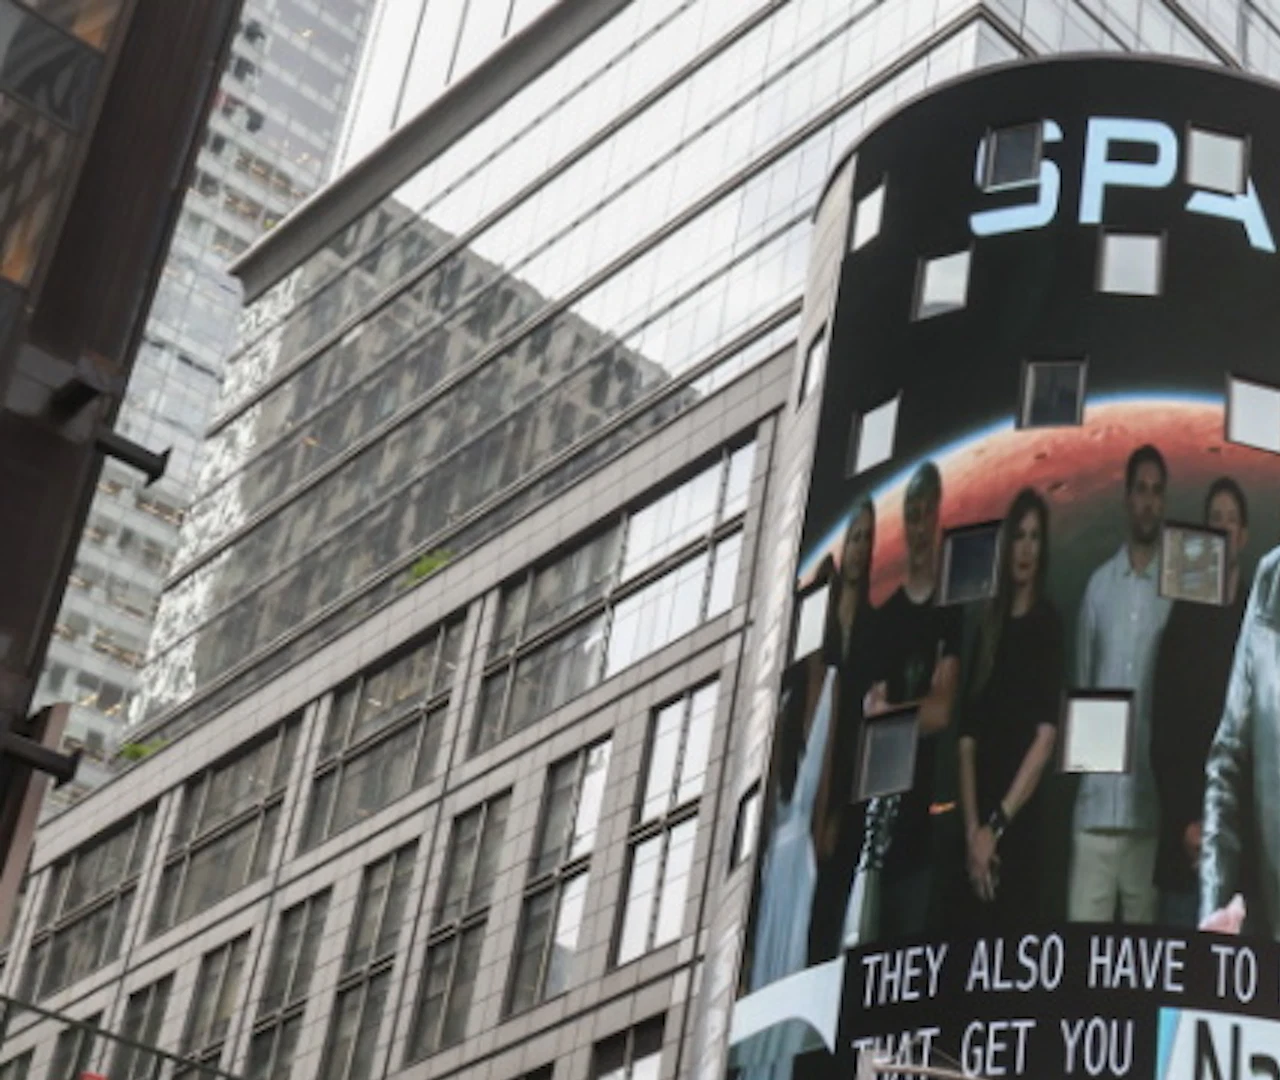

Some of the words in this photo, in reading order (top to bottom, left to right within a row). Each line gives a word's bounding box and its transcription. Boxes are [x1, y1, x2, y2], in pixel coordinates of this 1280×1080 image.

[862, 943, 948, 1009] THEY
[965, 933, 1065, 992] ALSO
[1088, 935, 1186, 992] HAVE
[1211, 944, 1257, 1003] TO
[961, 1020, 1036, 1077] GET
[1060, 1016, 1134, 1076] YOU
